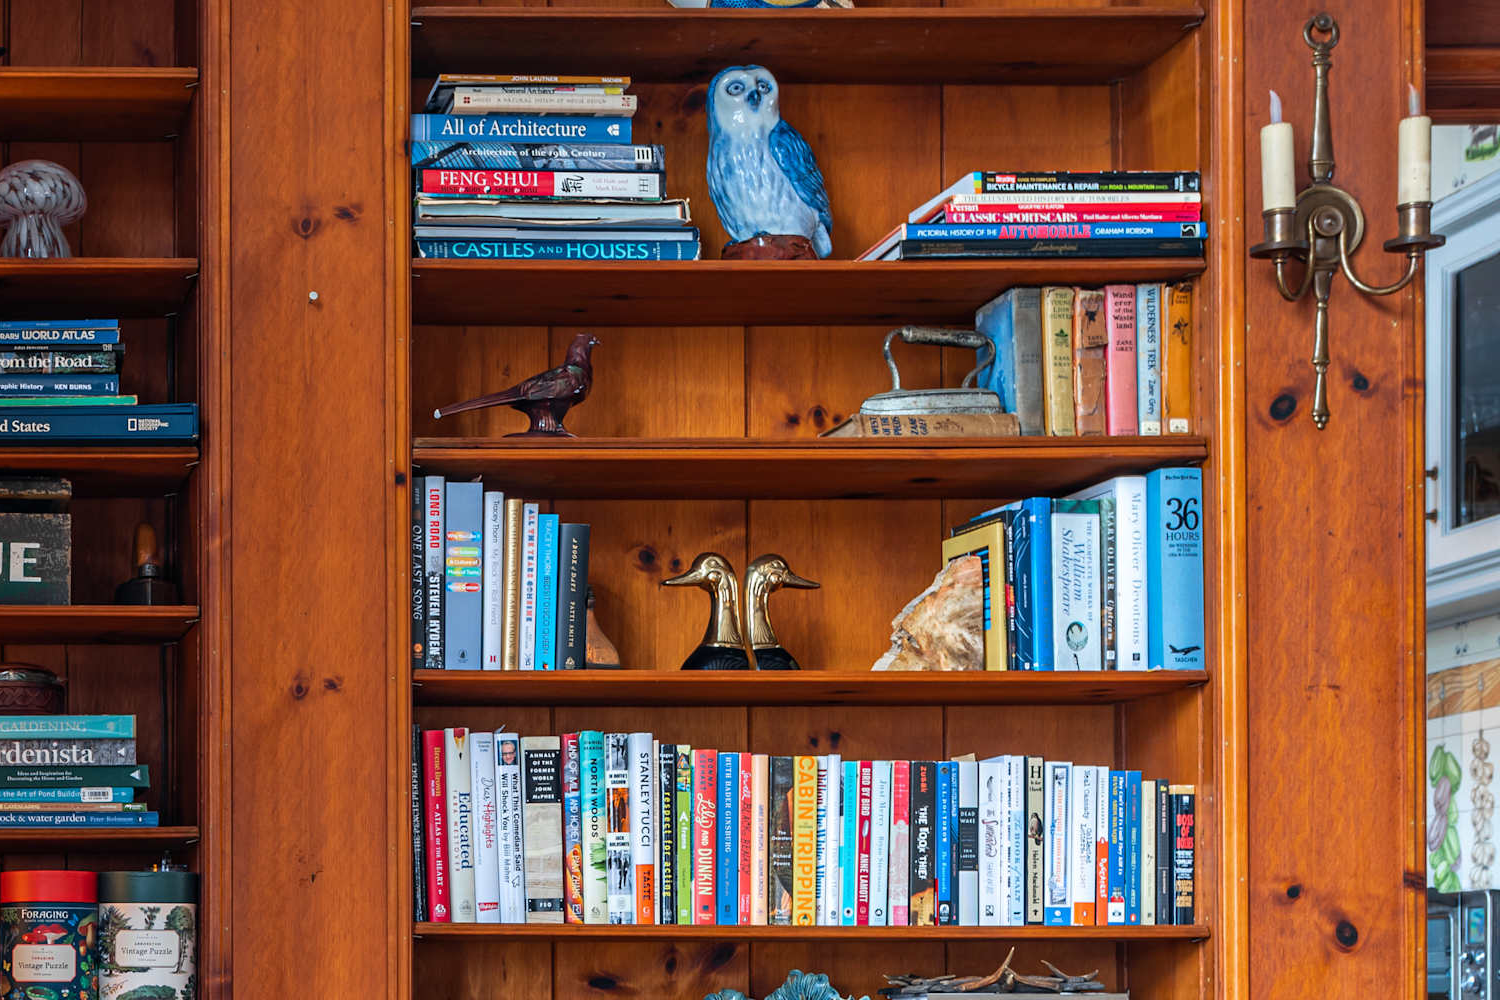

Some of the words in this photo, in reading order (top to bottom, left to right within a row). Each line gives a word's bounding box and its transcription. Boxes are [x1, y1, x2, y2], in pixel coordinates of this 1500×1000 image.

[442, 120, 466, 135] All
[468, 120, 486, 136] of
[489, 120, 587, 137] Architecture
[440, 172, 487, 186] FENG
[493, 172, 539, 186] SHUI
[952, 212, 1000, 223] CLASSIC
[1002, 212, 1078, 223] SPORTSCARS
[452, 242, 534, 257] CASTLES
[539, 246, 563, 254] AND
[566, 243, 648, 259] HOUSES
[1146, 289, 1156, 344] WILDERNESS
[22, 331, 59, 340] WORLD
[62, 331, 96, 340] ATLAS
[28, 356, 50, 368] the
[54, 356, 92, 368] Road
[1147, 349, 1156, 370] TREK
[20, 383, 44, 391] History
[11, 420, 50, 433] States
[429, 488, 440, 516] LONG
[491, 500, 499, 522] Tracey
[1130, 492, 1142, 526] Mary
[1166, 497, 1200, 531] 36
[412, 525, 422, 550] ONE
[430, 520, 440, 549] ROAD
[1107, 511, 1115, 542] MARY
[1166, 532, 1200, 542] HOURS
[1131, 530, 1142, 572] Oliver
[412, 554, 422, 583] LAST
[1058, 528, 1074, 616] Shakespeare
[1072, 542, 1086, 602] William
[413, 586, 422, 620] SONG
[429, 576, 440, 616] STEVEN
[1132, 579, 1142, 645] Devotions
[429, 620, 440, 656] HYDEN
[568, 624, 576, 648] SMITH
[0, 720, 86, 732] GARDENING
[501, 773, 509, 788] Will
[512, 773, 520, 794] What
[590, 758, 598, 795] NORTH
[640, 753, 650, 804] STANLEY
[863, 768, 871, 786] BIRD
[1030, 765, 1042, 778] H
[799, 755, 815, 820] CABIN
[862, 787, 871, 797] BY
[502, 790, 510, 814] Shock
[663, 792, 672, 834] respect
[696, 793, 716, 828] Lily
[862, 798, 870, 816] BIRD
[18, 815, 26, 823] &
[27, 814, 53, 823] water
[54, 814, 86, 825] garden
[502, 816, 510, 830] You
[591, 798, 599, 838] WOODS
[641, 809, 650, 847] TUCCI
[458, 792, 473, 870] Educated
[502, 832, 510, 842] by
[513, 814, 521, 852] Comedian
[701, 830, 709, 846] AND
[503, 843, 511, 856] Bill
[664, 839, 672, 856] for
[698, 848, 713, 895] DUNKIN
[860, 853, 869, 873] ANNE
[643, 870, 651, 900] TASTE
[662, 861, 674, 897] acting
[797, 830, 812, 926] TRIPPING
[859, 875, 868, 902] LAMOTT
[121, 947, 148, 956] Vintage
[18, 962, 44, 970] Vintage
